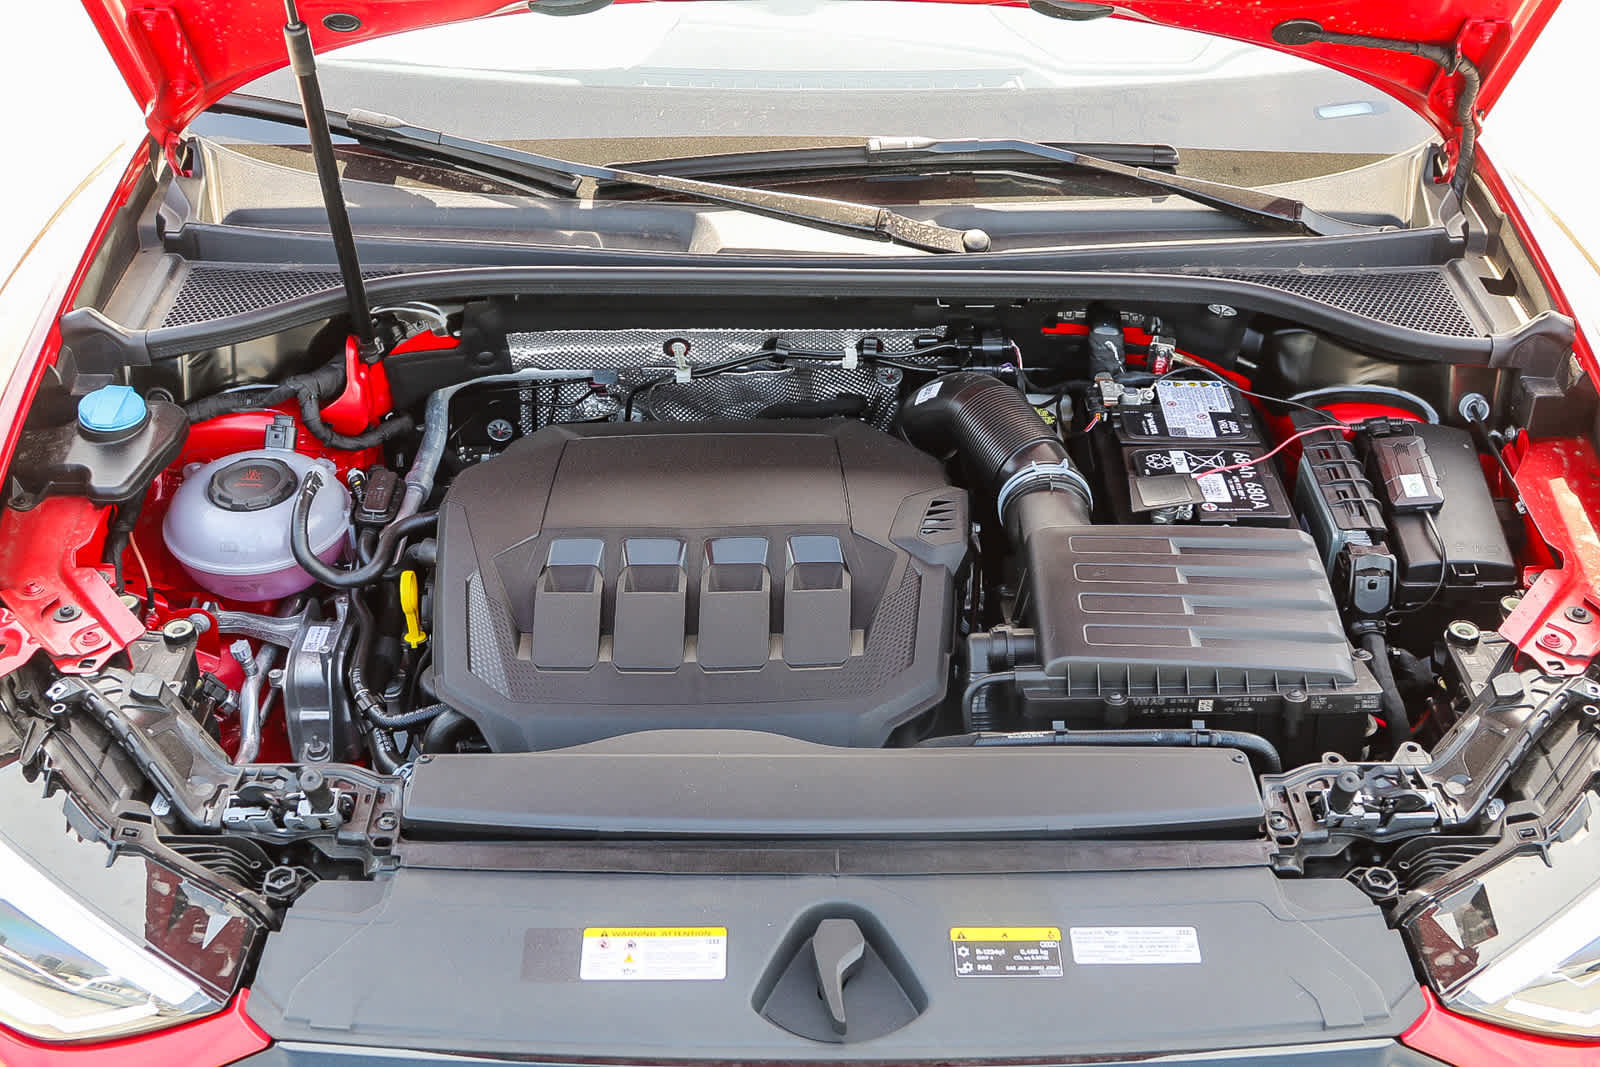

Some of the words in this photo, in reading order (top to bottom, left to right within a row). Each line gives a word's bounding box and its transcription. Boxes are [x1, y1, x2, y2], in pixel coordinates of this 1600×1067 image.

[1231, 451, 1258, 479] 68Ah
[1243, 480, 1270, 510] 680A
[661, 929, 712, 937] ATTENTION
